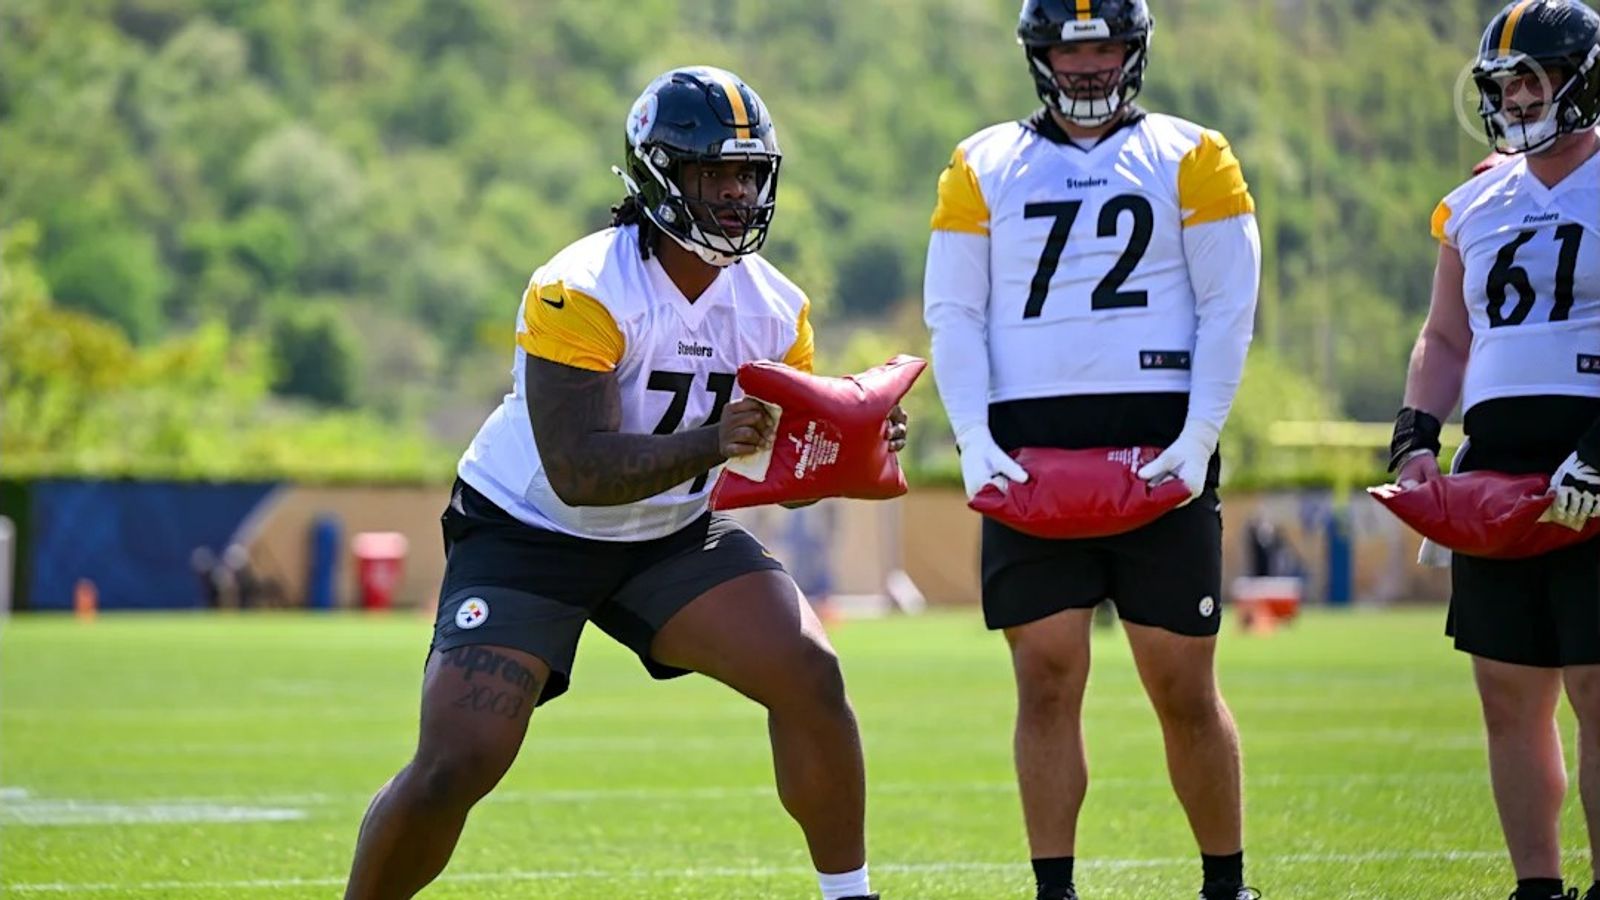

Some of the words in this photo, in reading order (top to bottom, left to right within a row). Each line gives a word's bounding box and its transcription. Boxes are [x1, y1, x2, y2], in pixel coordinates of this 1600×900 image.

[1066, 176, 1109, 189] Steelers
[1522, 212, 1561, 223] Steelers
[1022, 193, 1155, 321] 72
[1485, 222, 1585, 329] 61
[677, 340, 714, 358] Steelers
[646, 370, 737, 495] 71
